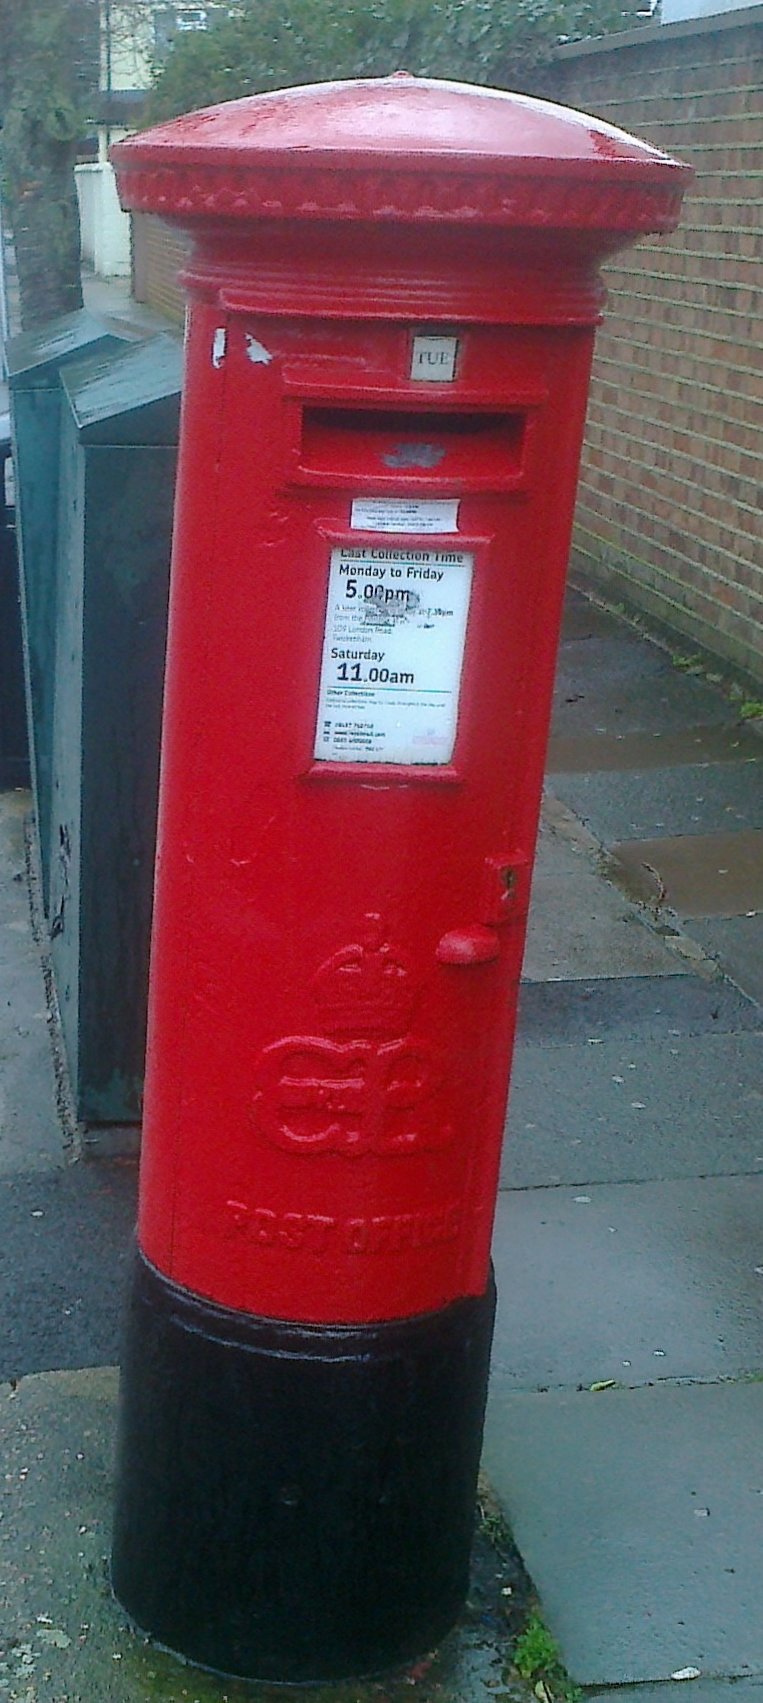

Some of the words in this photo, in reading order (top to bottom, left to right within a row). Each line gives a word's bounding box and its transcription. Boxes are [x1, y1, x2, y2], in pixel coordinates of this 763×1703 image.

[417, 352, 449, 365] TUE
[341, 549, 365, 559] Last
[371, 549, 429, 561] Collection
[434, 552, 463, 563] Time
[340, 564, 386, 579] Monday
[390, 568, 402, 578] to
[407, 567, 444, 582] Friday
[345, 579, 410, 603] 5.00pm
[331, 648, 385, 662] Saturday
[337, 662, 414, 684] 11.00am
[224, 1199, 337, 1256] POST
